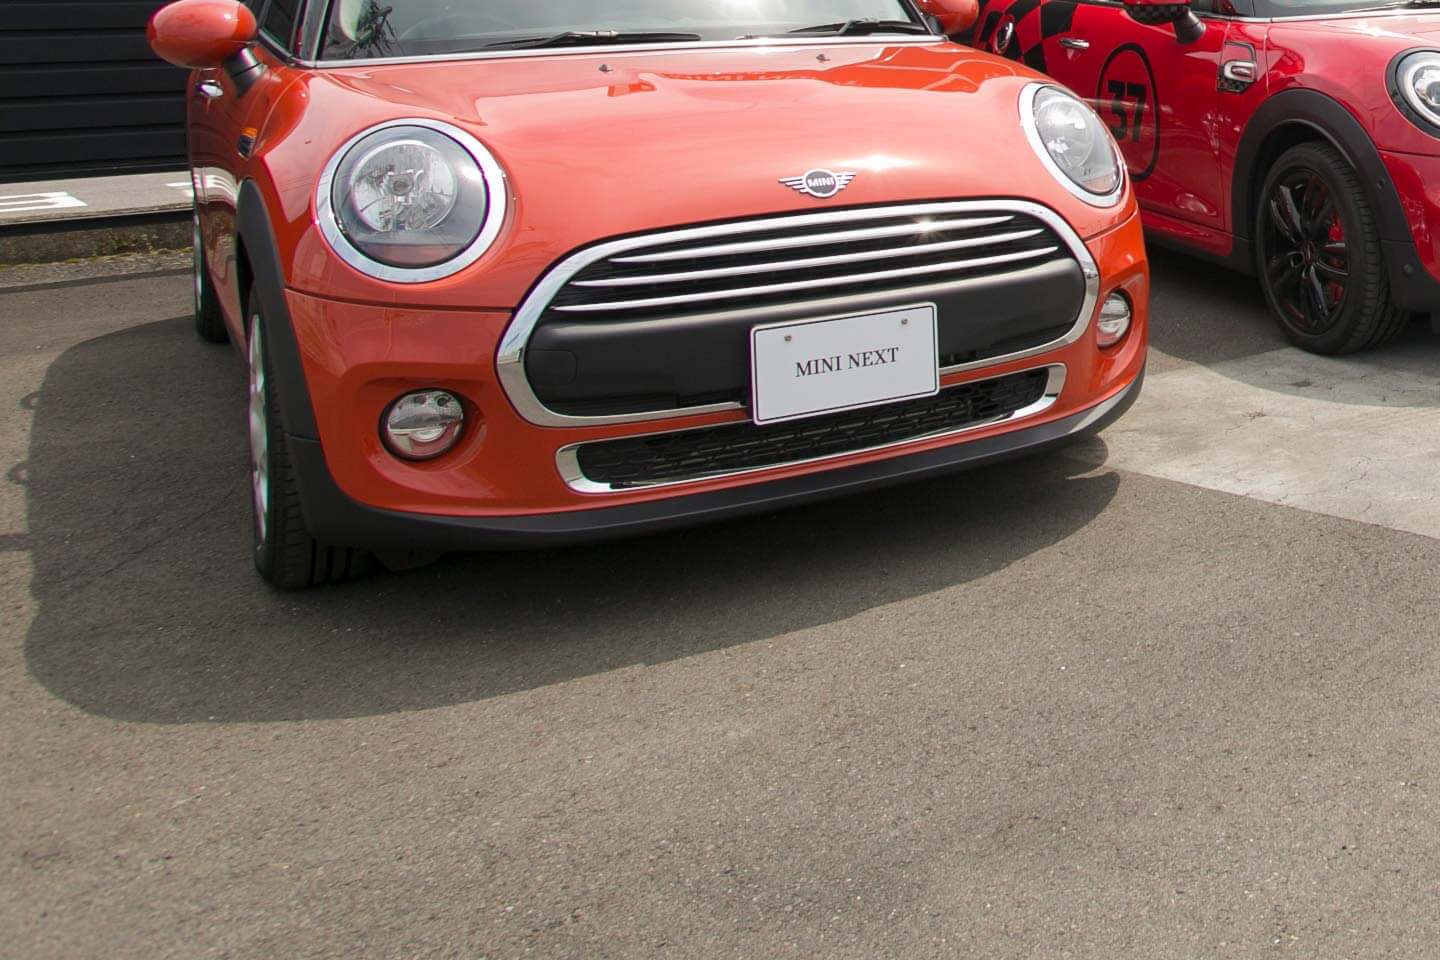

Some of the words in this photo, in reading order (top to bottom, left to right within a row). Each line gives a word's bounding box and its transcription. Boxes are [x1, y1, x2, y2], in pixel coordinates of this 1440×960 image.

[1107, 80, 1146, 143] 37
[807, 176, 835, 188] MINI
[795, 355, 842, 378] MINI
[847, 346, 899, 370] NEXT
